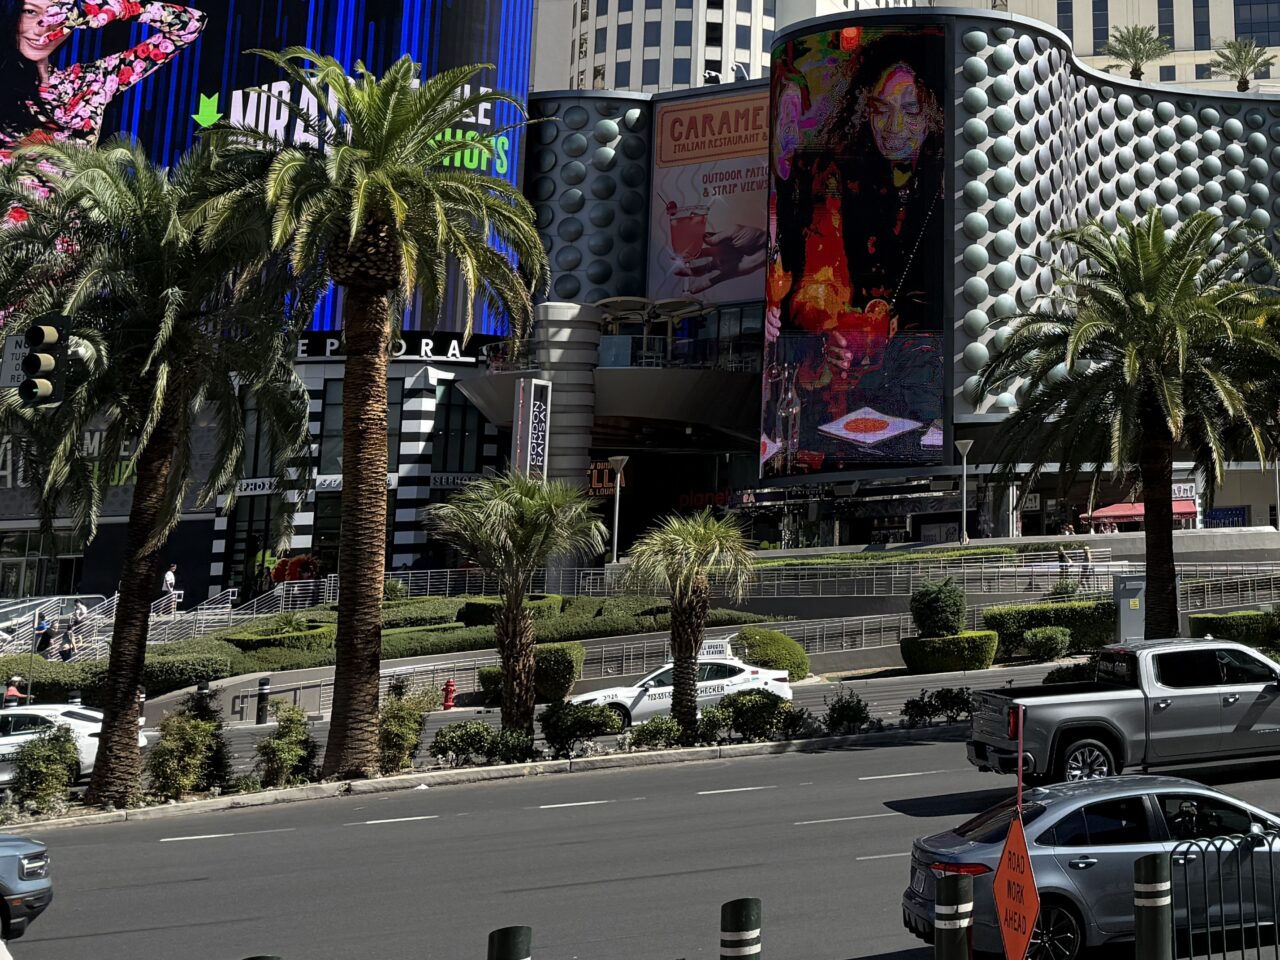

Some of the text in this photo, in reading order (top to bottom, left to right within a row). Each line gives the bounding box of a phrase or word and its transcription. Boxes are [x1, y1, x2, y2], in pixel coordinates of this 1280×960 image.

[673, 140, 706, 154] ITALIAN
[708, 132, 760, 148] RESTAURANT
[702, 169, 742, 184] OUTDOOR
[702, 180, 769, 197] & STRIP VIEWS
[11, 353, 27, 361] TUR
[298, 339, 460, 358] EPORA
[530, 401, 541, 465] GORDON
[536, 402, 547, 466] RAMSAY
[699, 683, 725, 695] HECKER
[1007, 851, 1025, 875] ROAD
[1006, 879, 1025, 905] WORK
[1003, 907, 1027, 936] AHEAD
